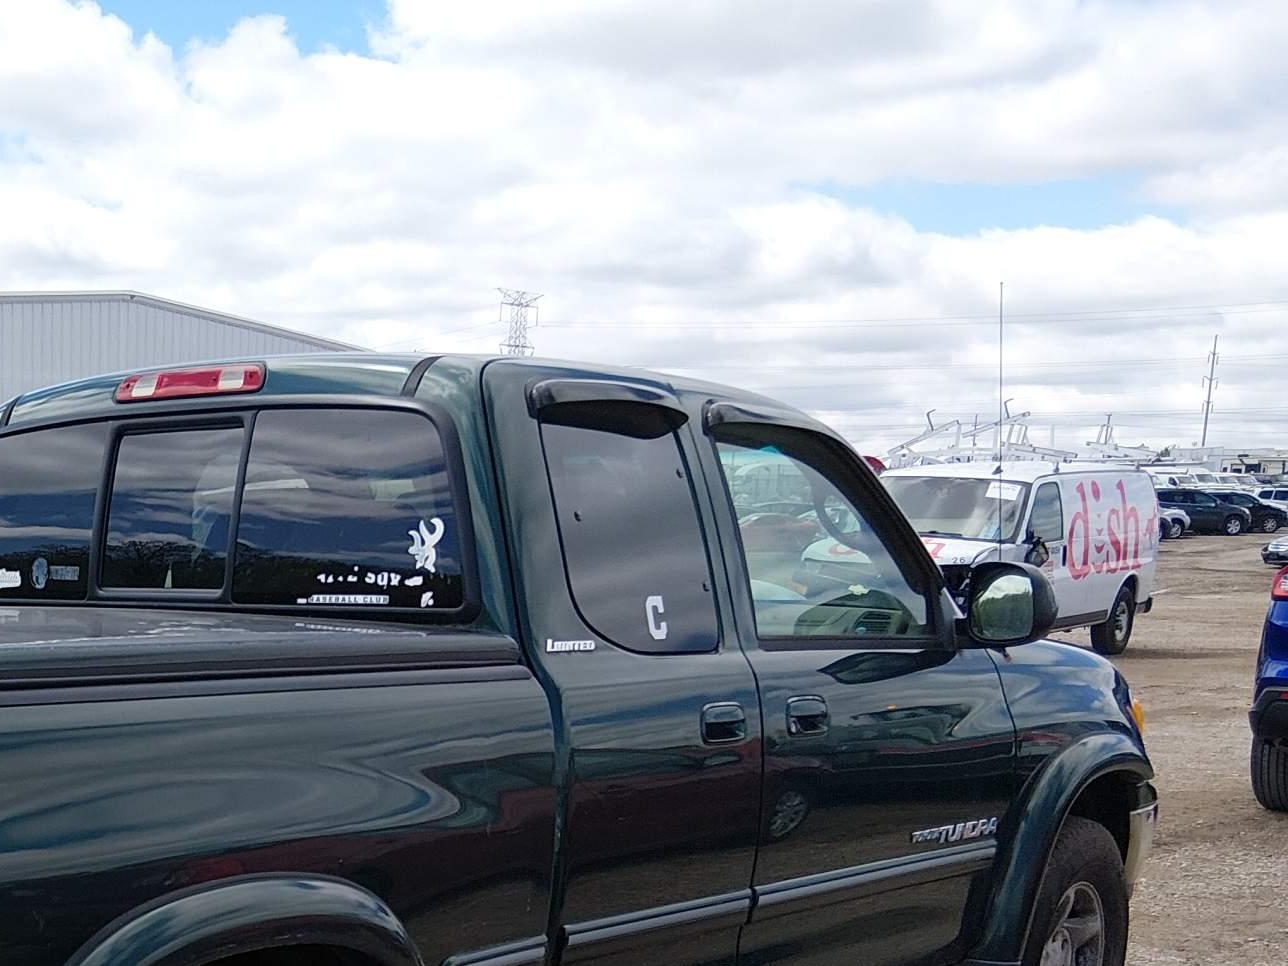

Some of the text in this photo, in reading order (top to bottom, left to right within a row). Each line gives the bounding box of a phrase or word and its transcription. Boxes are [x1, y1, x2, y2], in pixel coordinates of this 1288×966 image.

[1068, 479, 1143, 580] dish
[646, 596, 667, 640] C
[938, 817, 999, 843] TUNDRA
